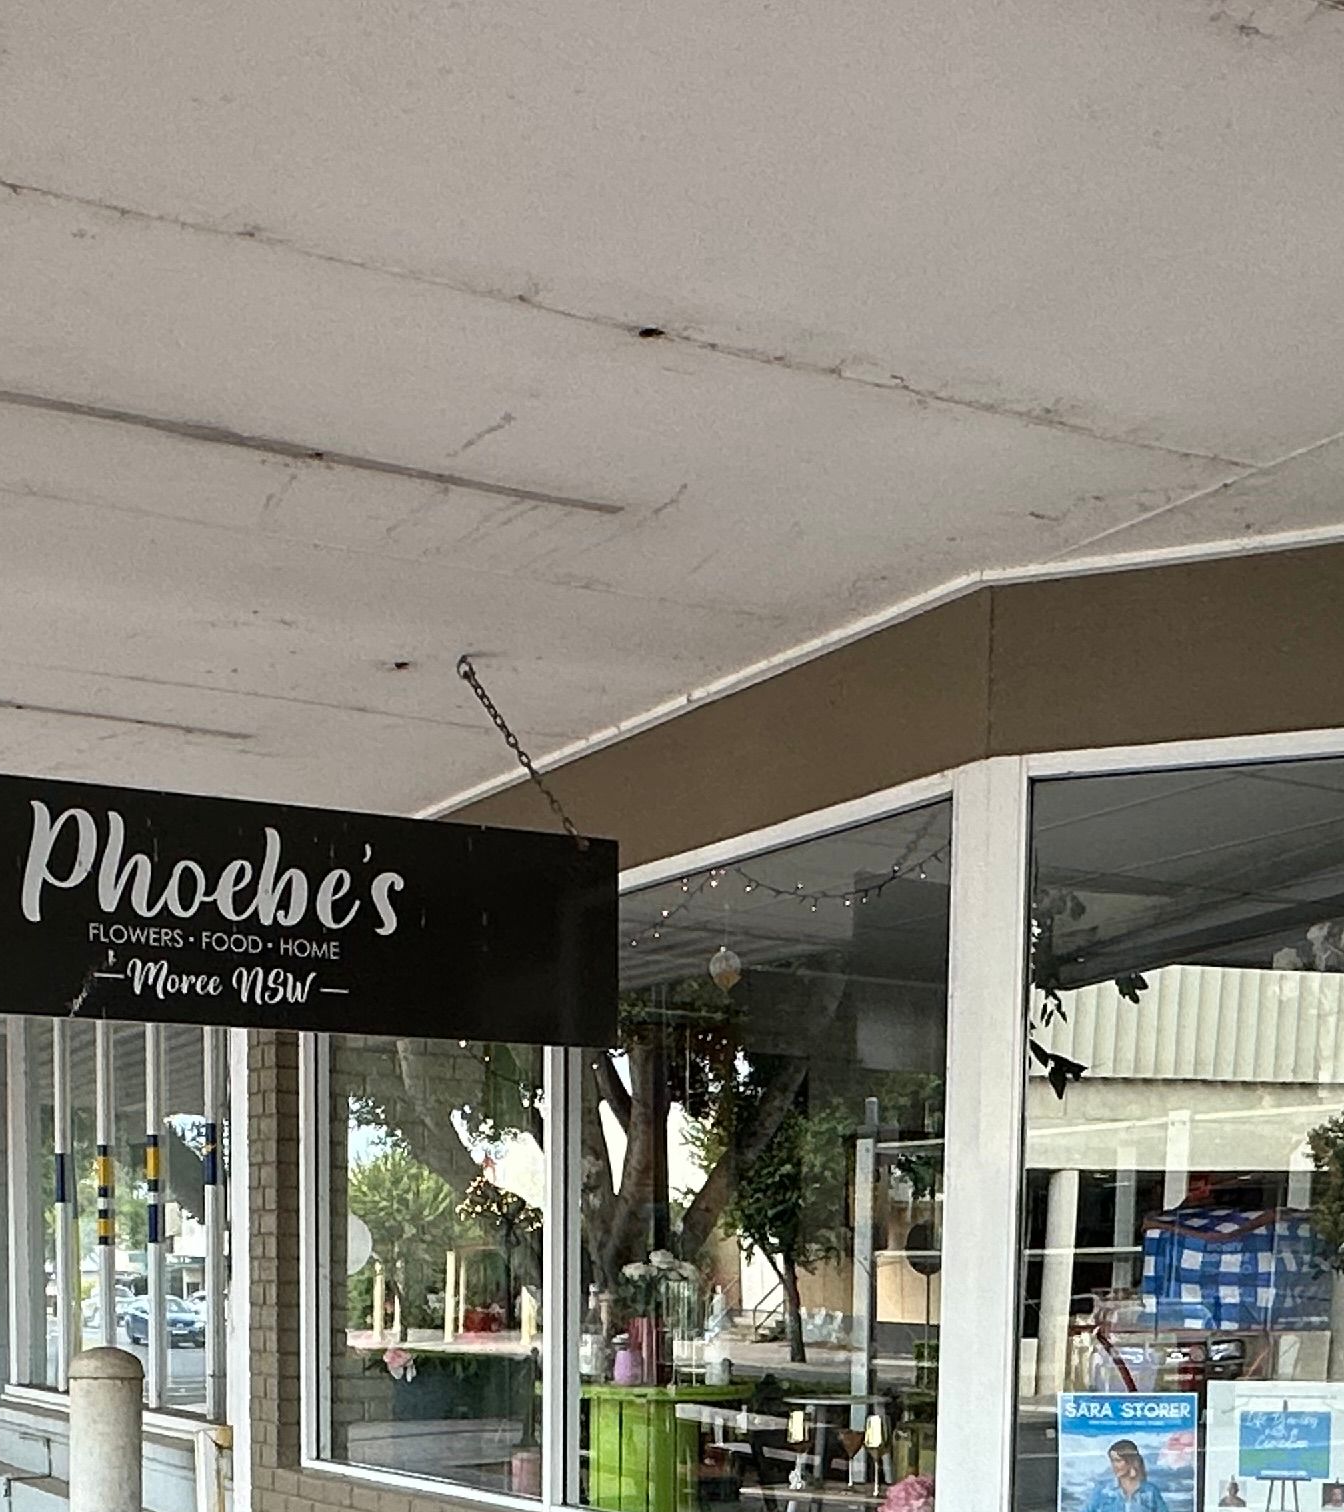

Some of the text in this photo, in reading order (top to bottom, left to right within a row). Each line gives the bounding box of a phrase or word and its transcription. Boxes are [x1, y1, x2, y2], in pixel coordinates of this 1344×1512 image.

[21, 800, 405, 936] Phoebe's
[88, 922, 341, 961] FLOWERS FOOD HOME
[126, 957, 318, 1006] Moree NSW
[1064, 1401, 1192, 1418] SARA STORER
